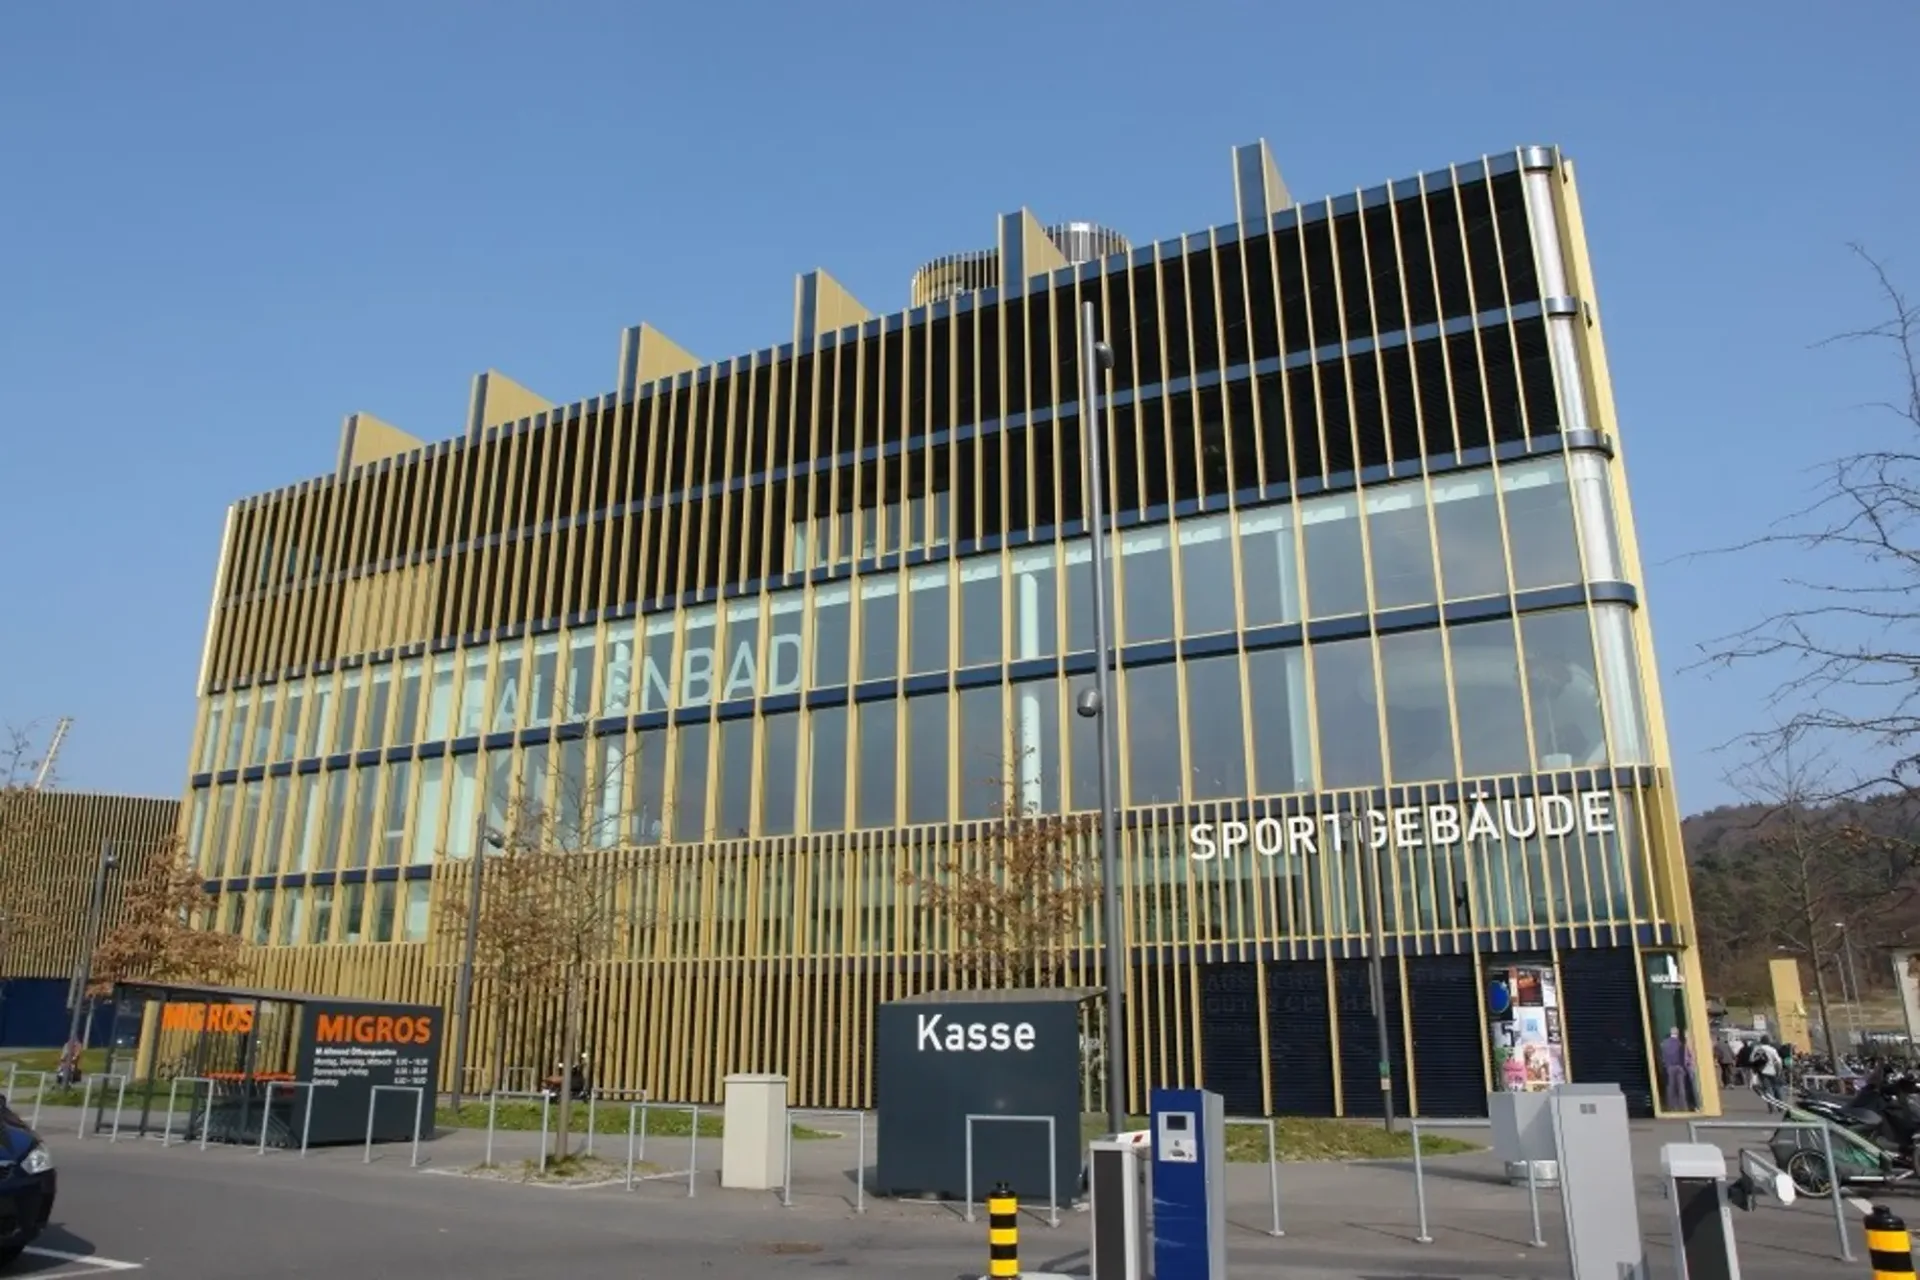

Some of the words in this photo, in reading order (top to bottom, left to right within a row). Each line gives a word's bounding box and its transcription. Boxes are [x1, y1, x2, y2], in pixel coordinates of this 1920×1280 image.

[163, 1003, 255, 1033] MIGROS
[316, 1014, 432, 1043] MIGROS
[918, 1013, 1036, 1051] Kasse
